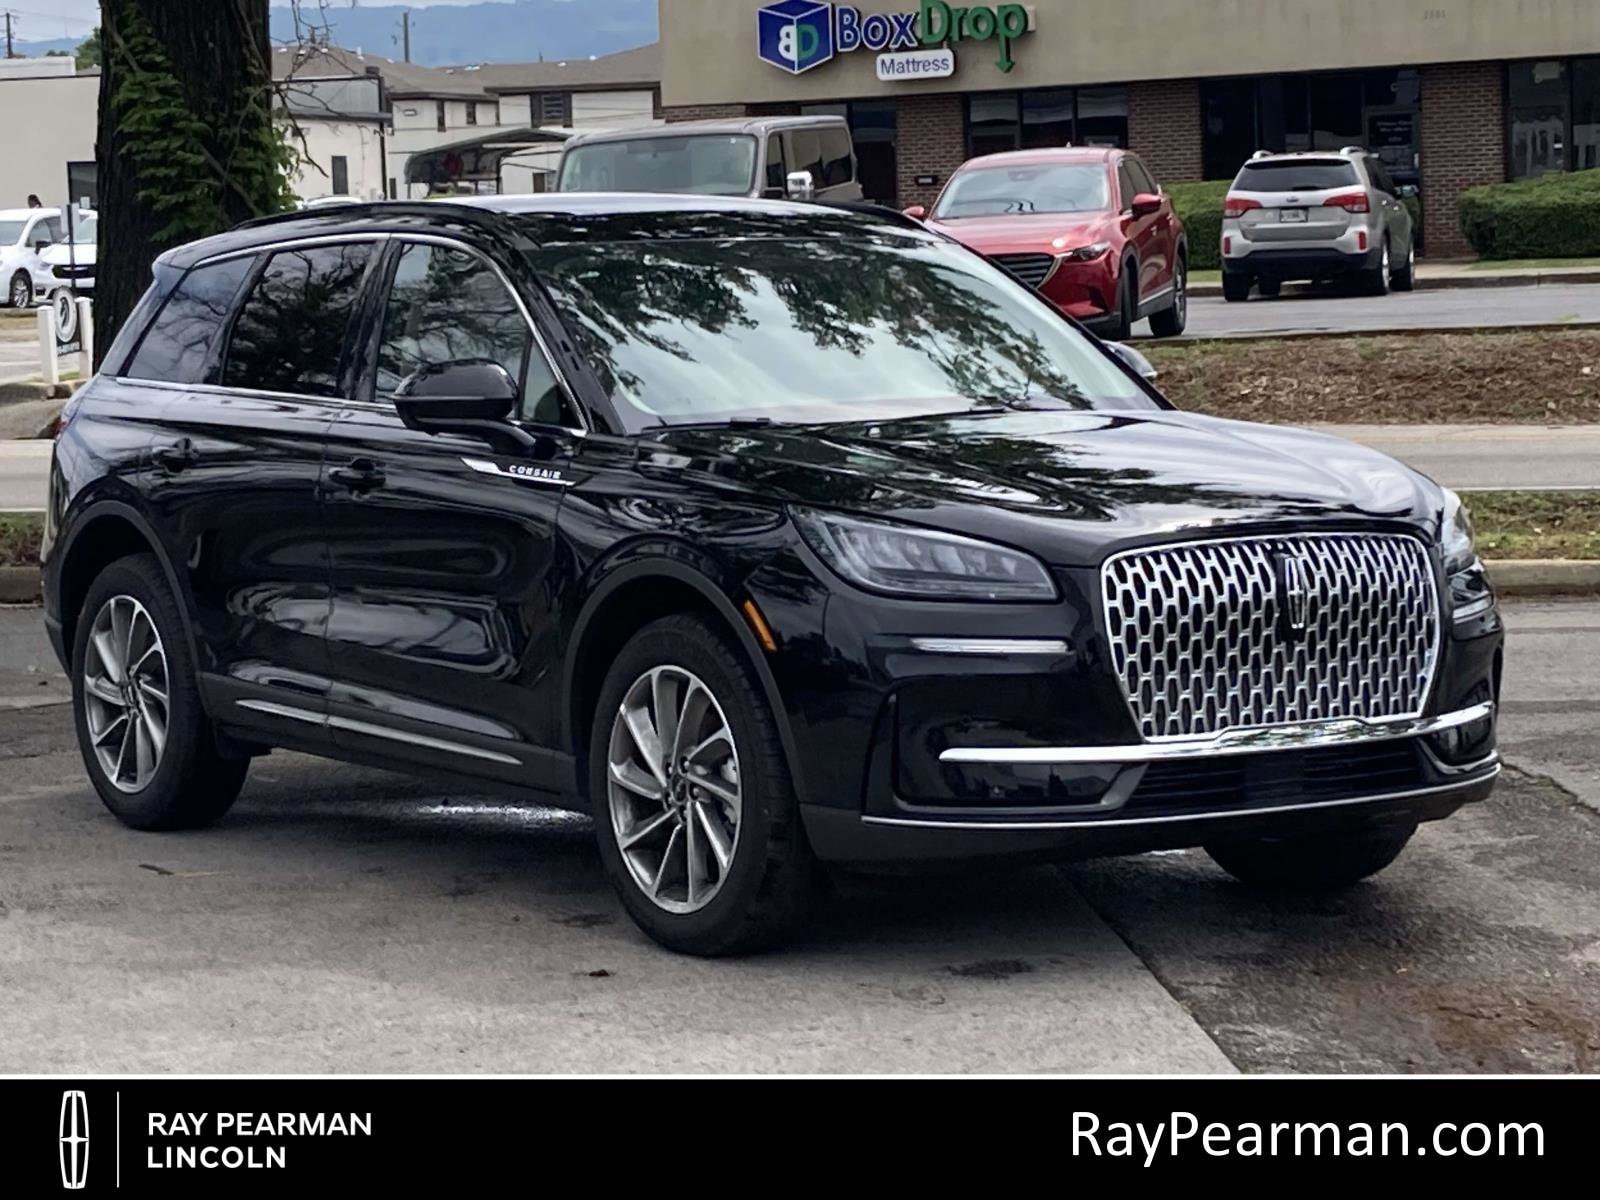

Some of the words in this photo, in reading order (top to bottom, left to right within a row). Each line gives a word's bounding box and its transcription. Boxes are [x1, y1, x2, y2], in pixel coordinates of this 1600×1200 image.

[836, 0, 1028, 73] BoxDrop
[880, 57, 949, 74] Mattress
[508, 464, 561, 479] CORSAIR
